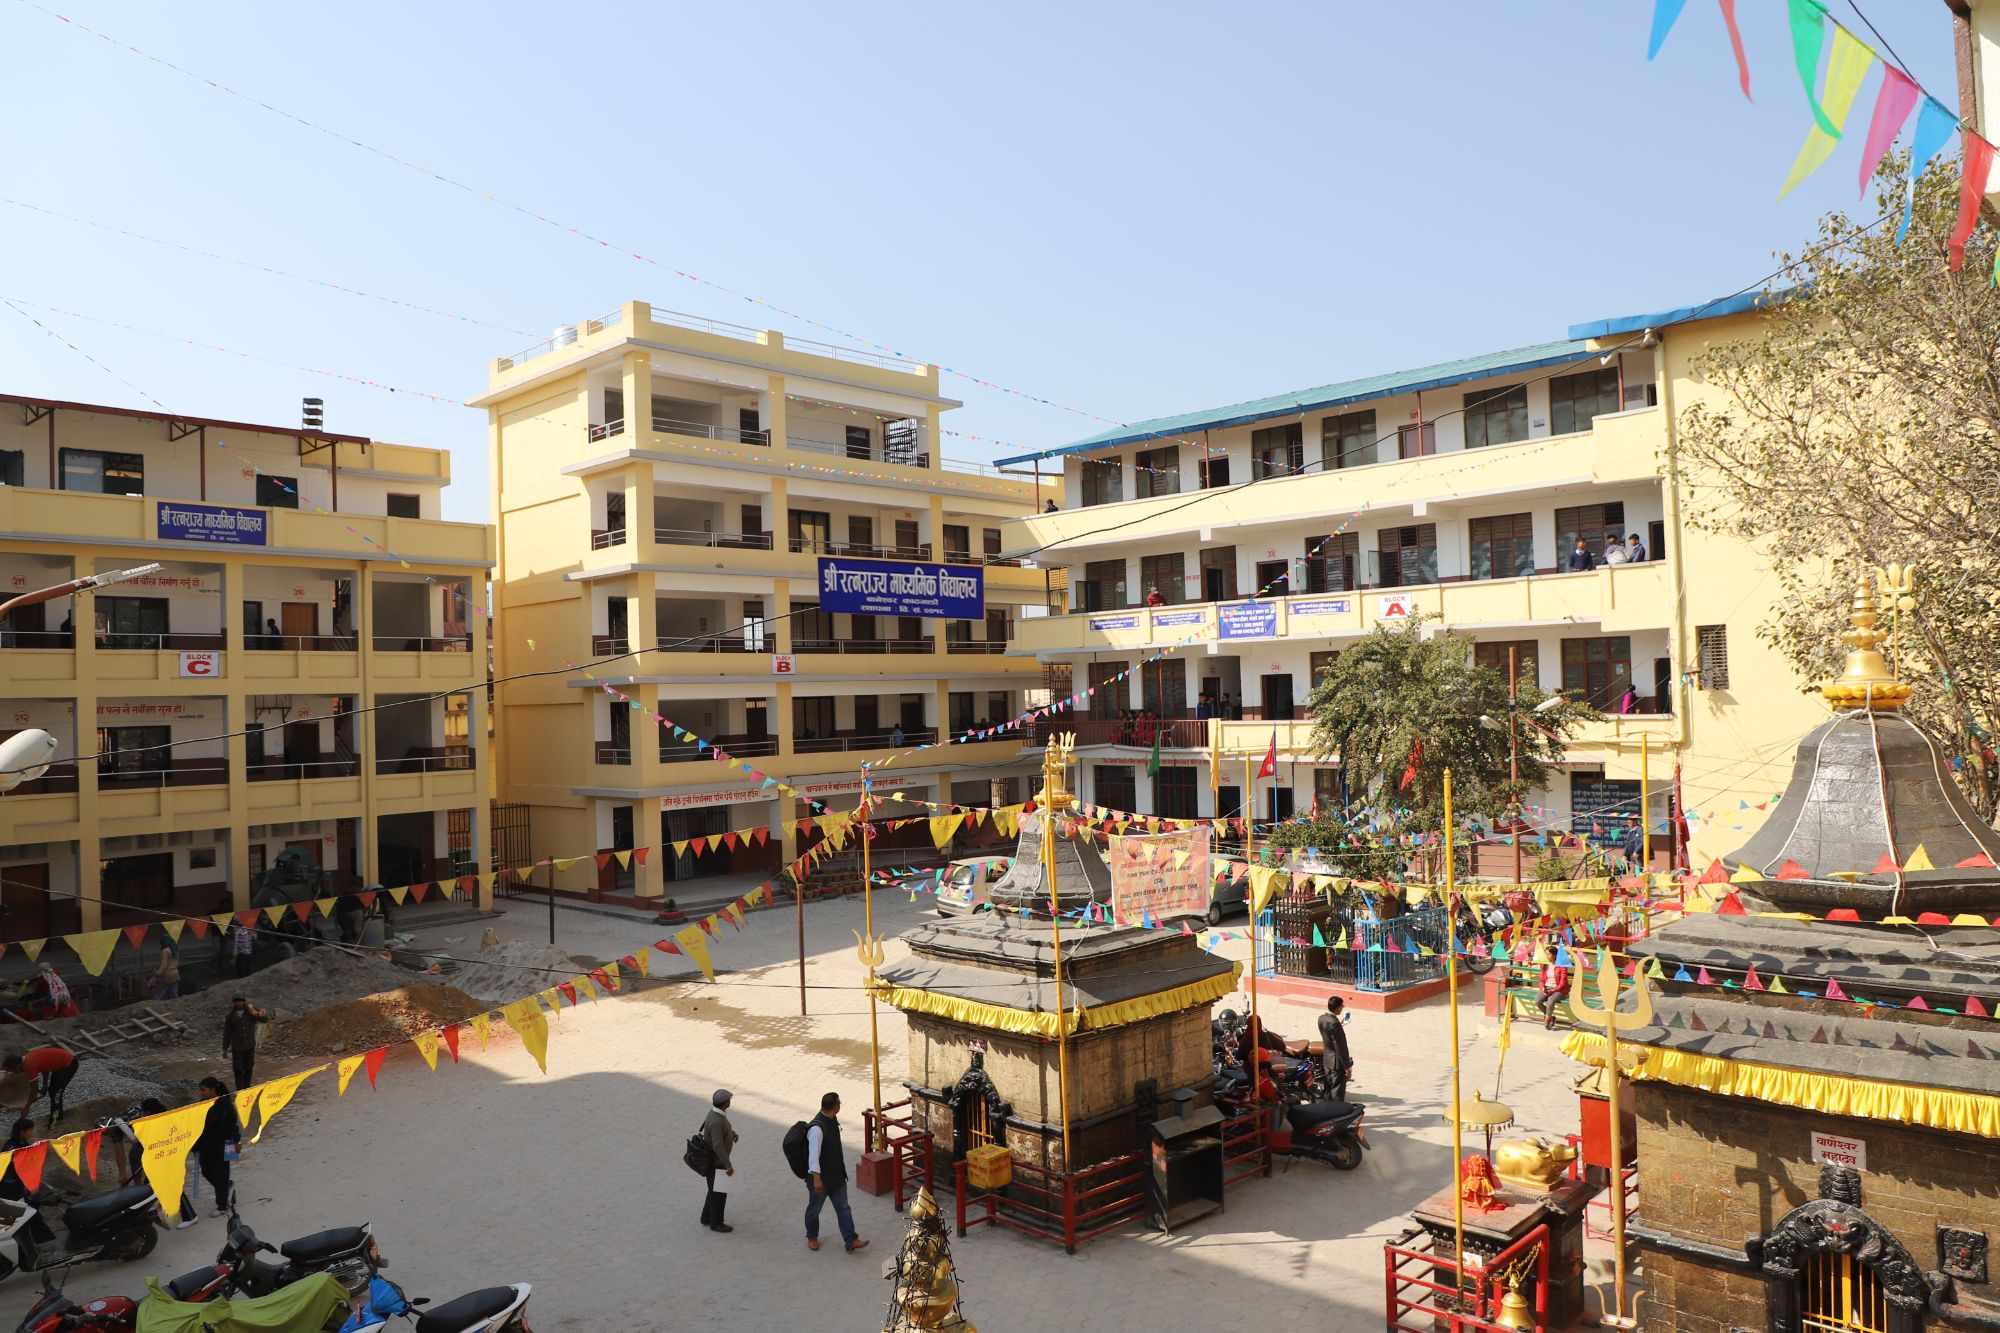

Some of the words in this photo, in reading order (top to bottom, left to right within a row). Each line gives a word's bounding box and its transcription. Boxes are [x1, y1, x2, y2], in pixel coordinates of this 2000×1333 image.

[824, 562, 837, 592] श्री
[837, 569, 888, 594] रत्नराज्य
[890, 566, 937, 597] माध्यमिक
[939, 568, 977, 599] विद्यालय
[1385, 603, 1406, 616] A
[187, 660, 211, 675] C
[777, 661, 791, 672] B
